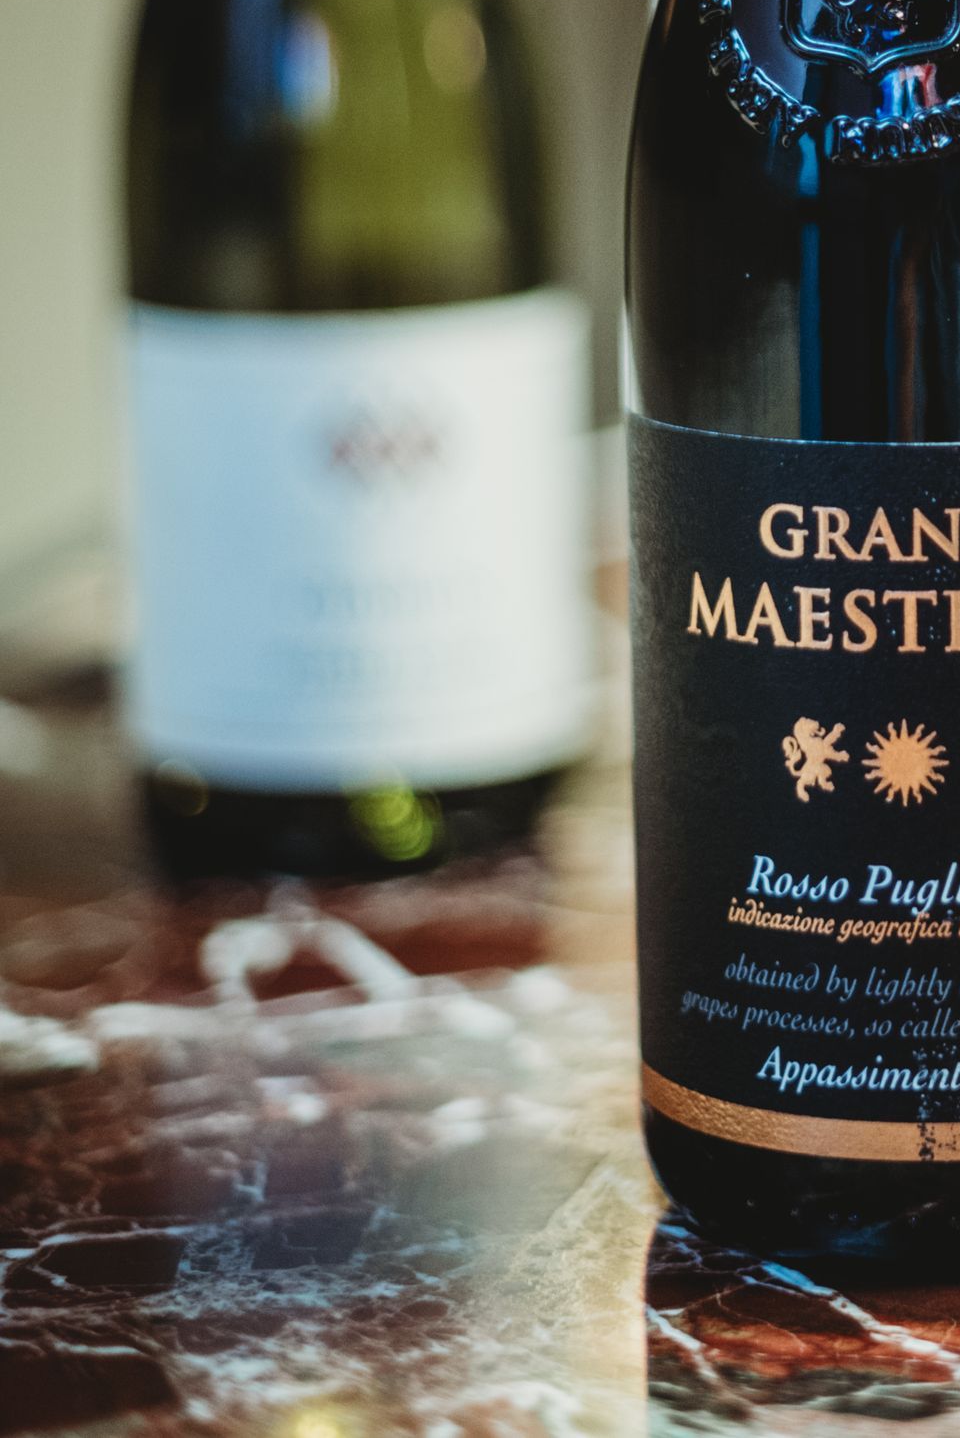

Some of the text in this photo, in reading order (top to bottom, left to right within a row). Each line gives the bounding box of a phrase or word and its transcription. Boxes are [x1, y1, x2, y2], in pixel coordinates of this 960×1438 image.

[747, 854, 850, 903] Rosso
[727, 897, 835, 936] indicazione
[836, 912, 953, 945] geografica
[724, 952, 821, 992] obtained
[825, 964, 858, 1003] by
[864, 965, 953, 1004] lightly
[681, 989, 739, 1022] grapes
[741, 1005, 856, 1039] processes,
[863, 1015, 893, 1038] so
